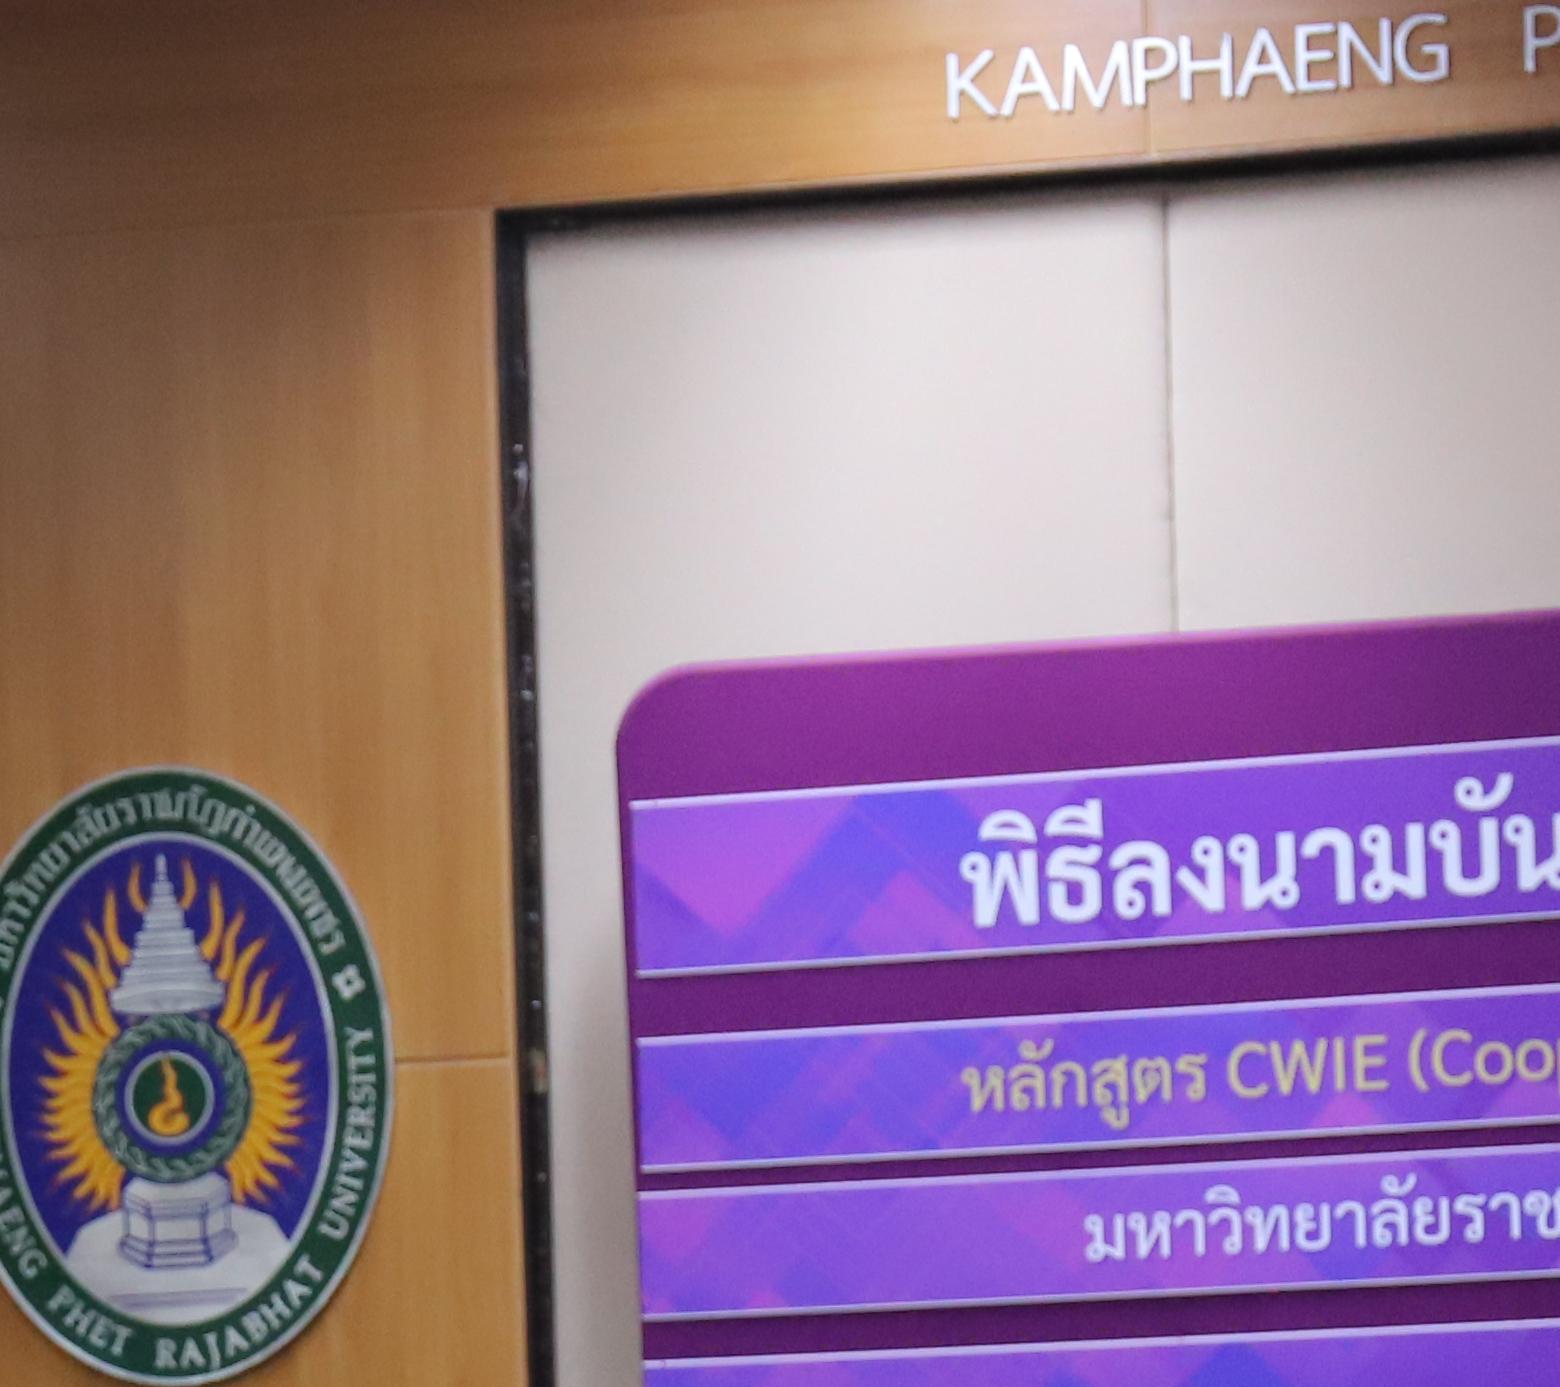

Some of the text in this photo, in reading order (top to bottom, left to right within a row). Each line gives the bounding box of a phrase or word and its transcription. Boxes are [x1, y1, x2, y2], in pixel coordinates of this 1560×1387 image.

[944, 12, 1452, 118] KAMPHAENG
[960, 1037, 1209, 1130] หลักสูตร
[1226, 1033, 1389, 1100] CWIE
[46, 1284, 132, 1358] PHET
[153, 1253, 324, 1371] RAJABHAT
[316, 1025, 377, 1241] UNIVERSITY
